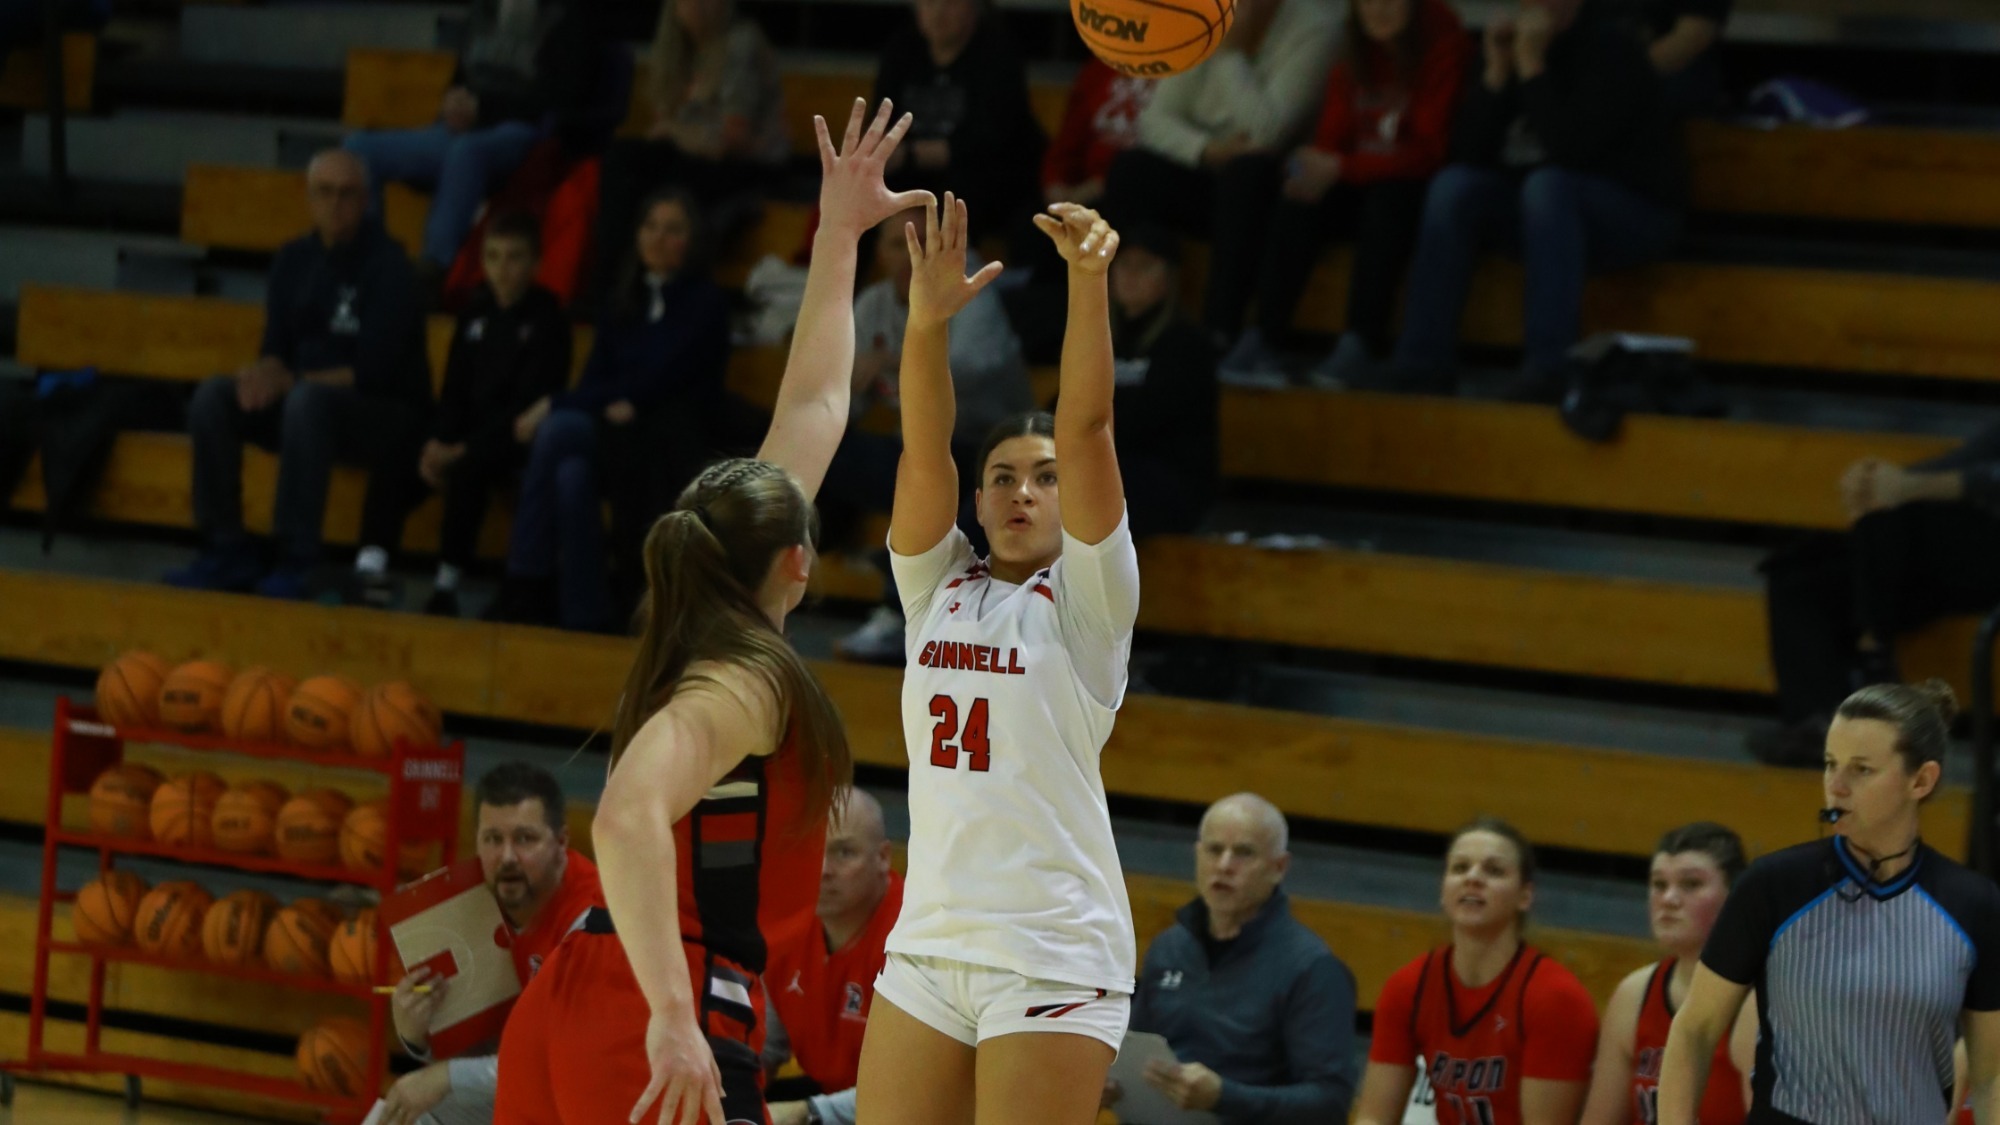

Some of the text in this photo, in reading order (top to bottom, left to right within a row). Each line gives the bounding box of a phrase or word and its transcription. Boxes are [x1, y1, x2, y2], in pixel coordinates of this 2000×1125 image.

[1079, 2, 1149, 42] NCAA
[919, 640, 1025, 674] GINNELL
[929, 694, 990, 772] 24
